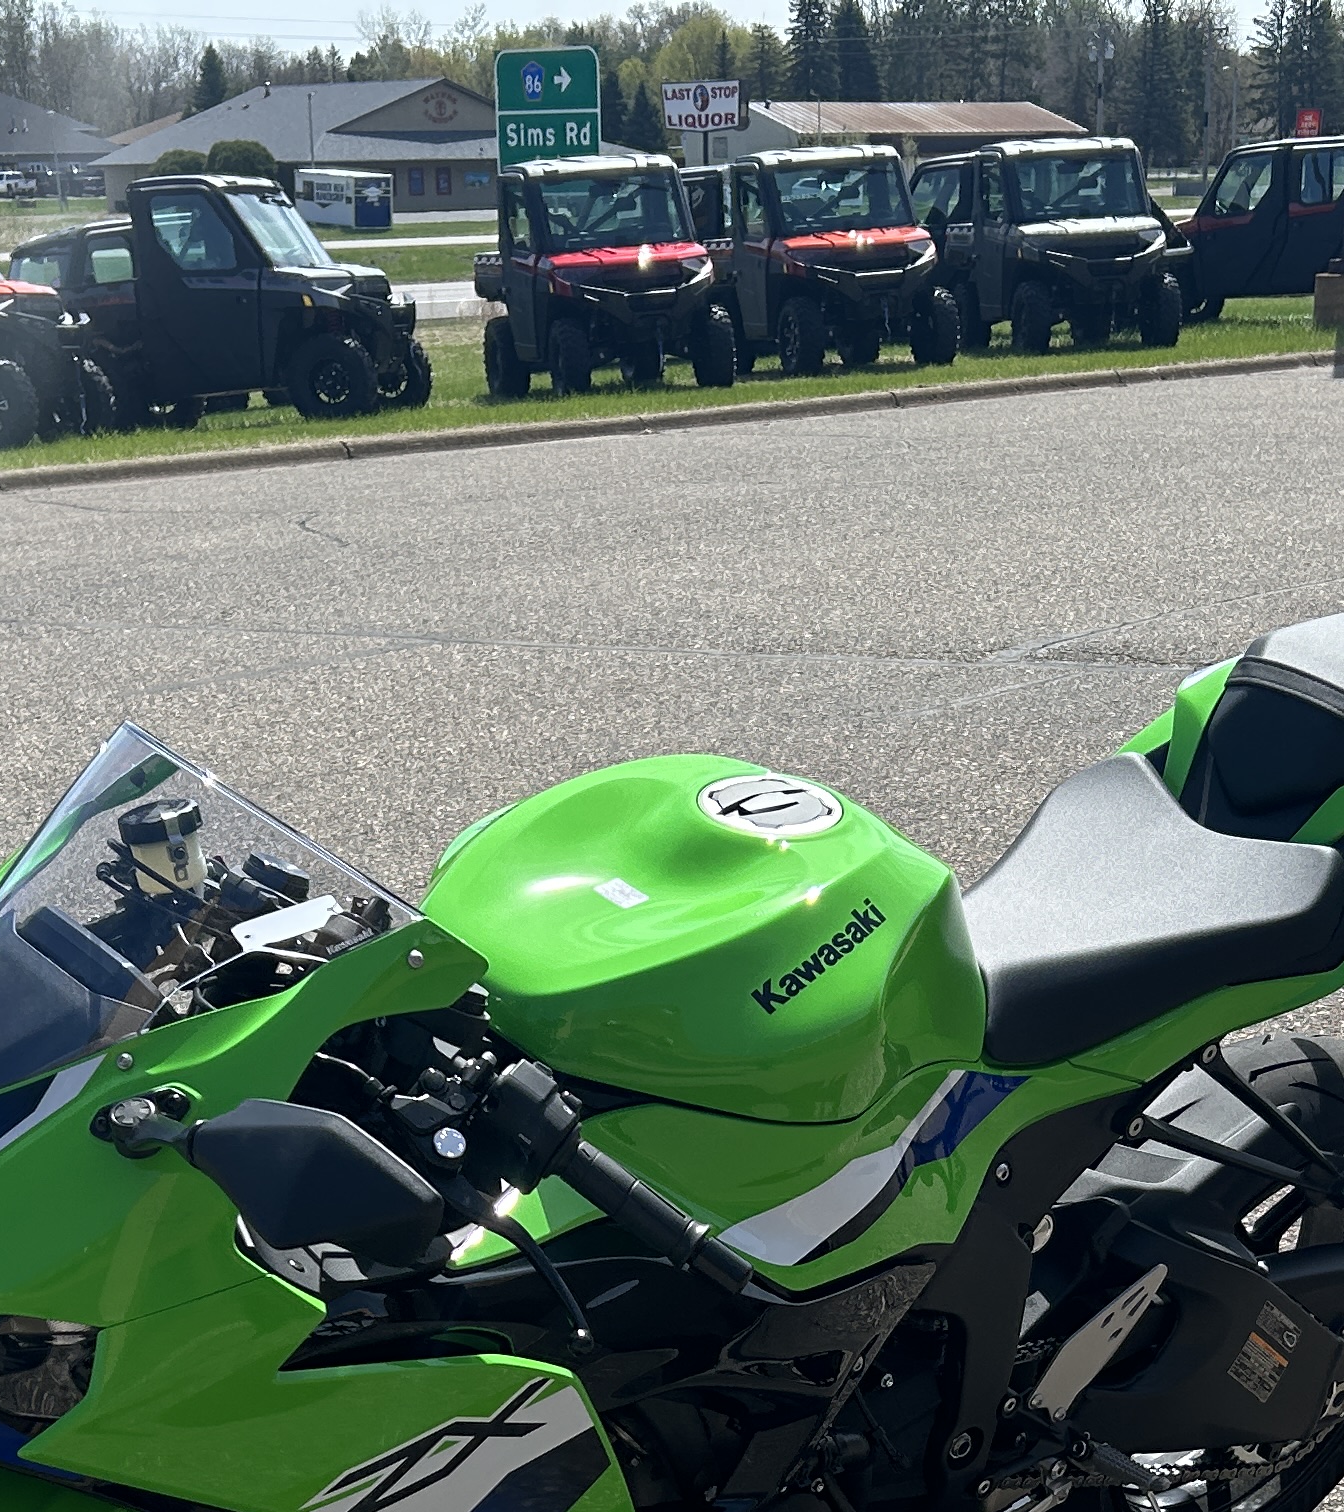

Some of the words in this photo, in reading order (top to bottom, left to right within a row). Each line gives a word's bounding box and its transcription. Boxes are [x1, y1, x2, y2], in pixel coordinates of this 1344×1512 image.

[525, 74, 542, 94] 86
[664, 88, 692, 101] LAST
[710, 86, 738, 99] STOP
[667, 112, 737, 129] LIQUOR
[506, 122, 556, 147] Sims
[565, 121, 591, 146] Rd
[751, 898, 887, 1015] Kawasaki
